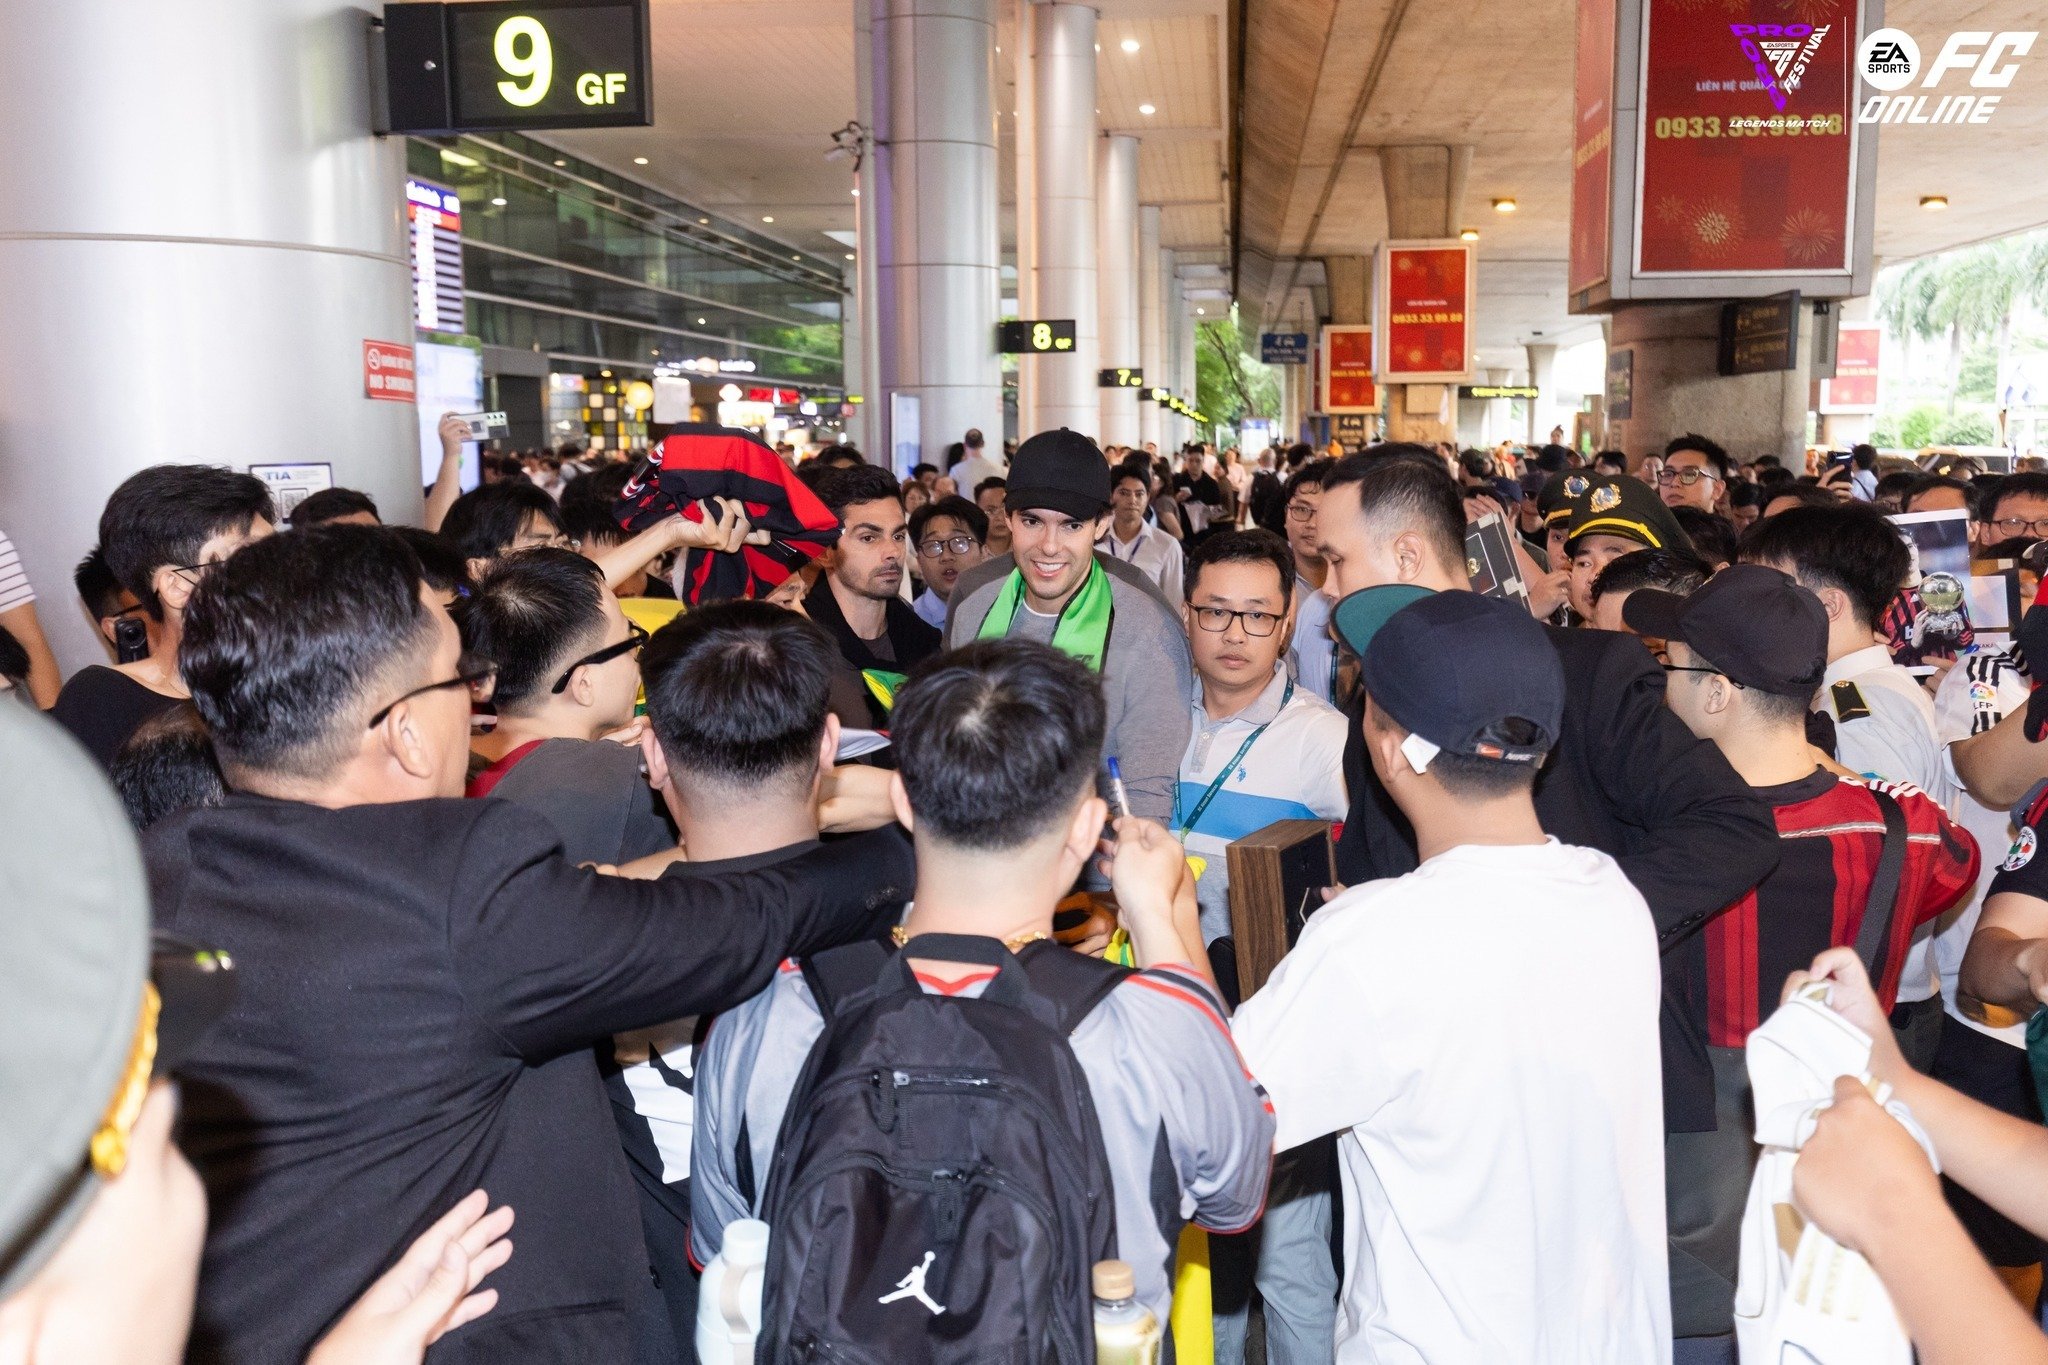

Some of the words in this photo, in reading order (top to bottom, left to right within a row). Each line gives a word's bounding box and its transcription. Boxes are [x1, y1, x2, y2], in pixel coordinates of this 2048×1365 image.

[494, 15, 553, 107] 9
[576, 72, 627, 105] GF
[1032, 322, 1052, 350] 8
[1117, 369, 1131, 386] 7
[1973, 701, 1993, 710] LFP
